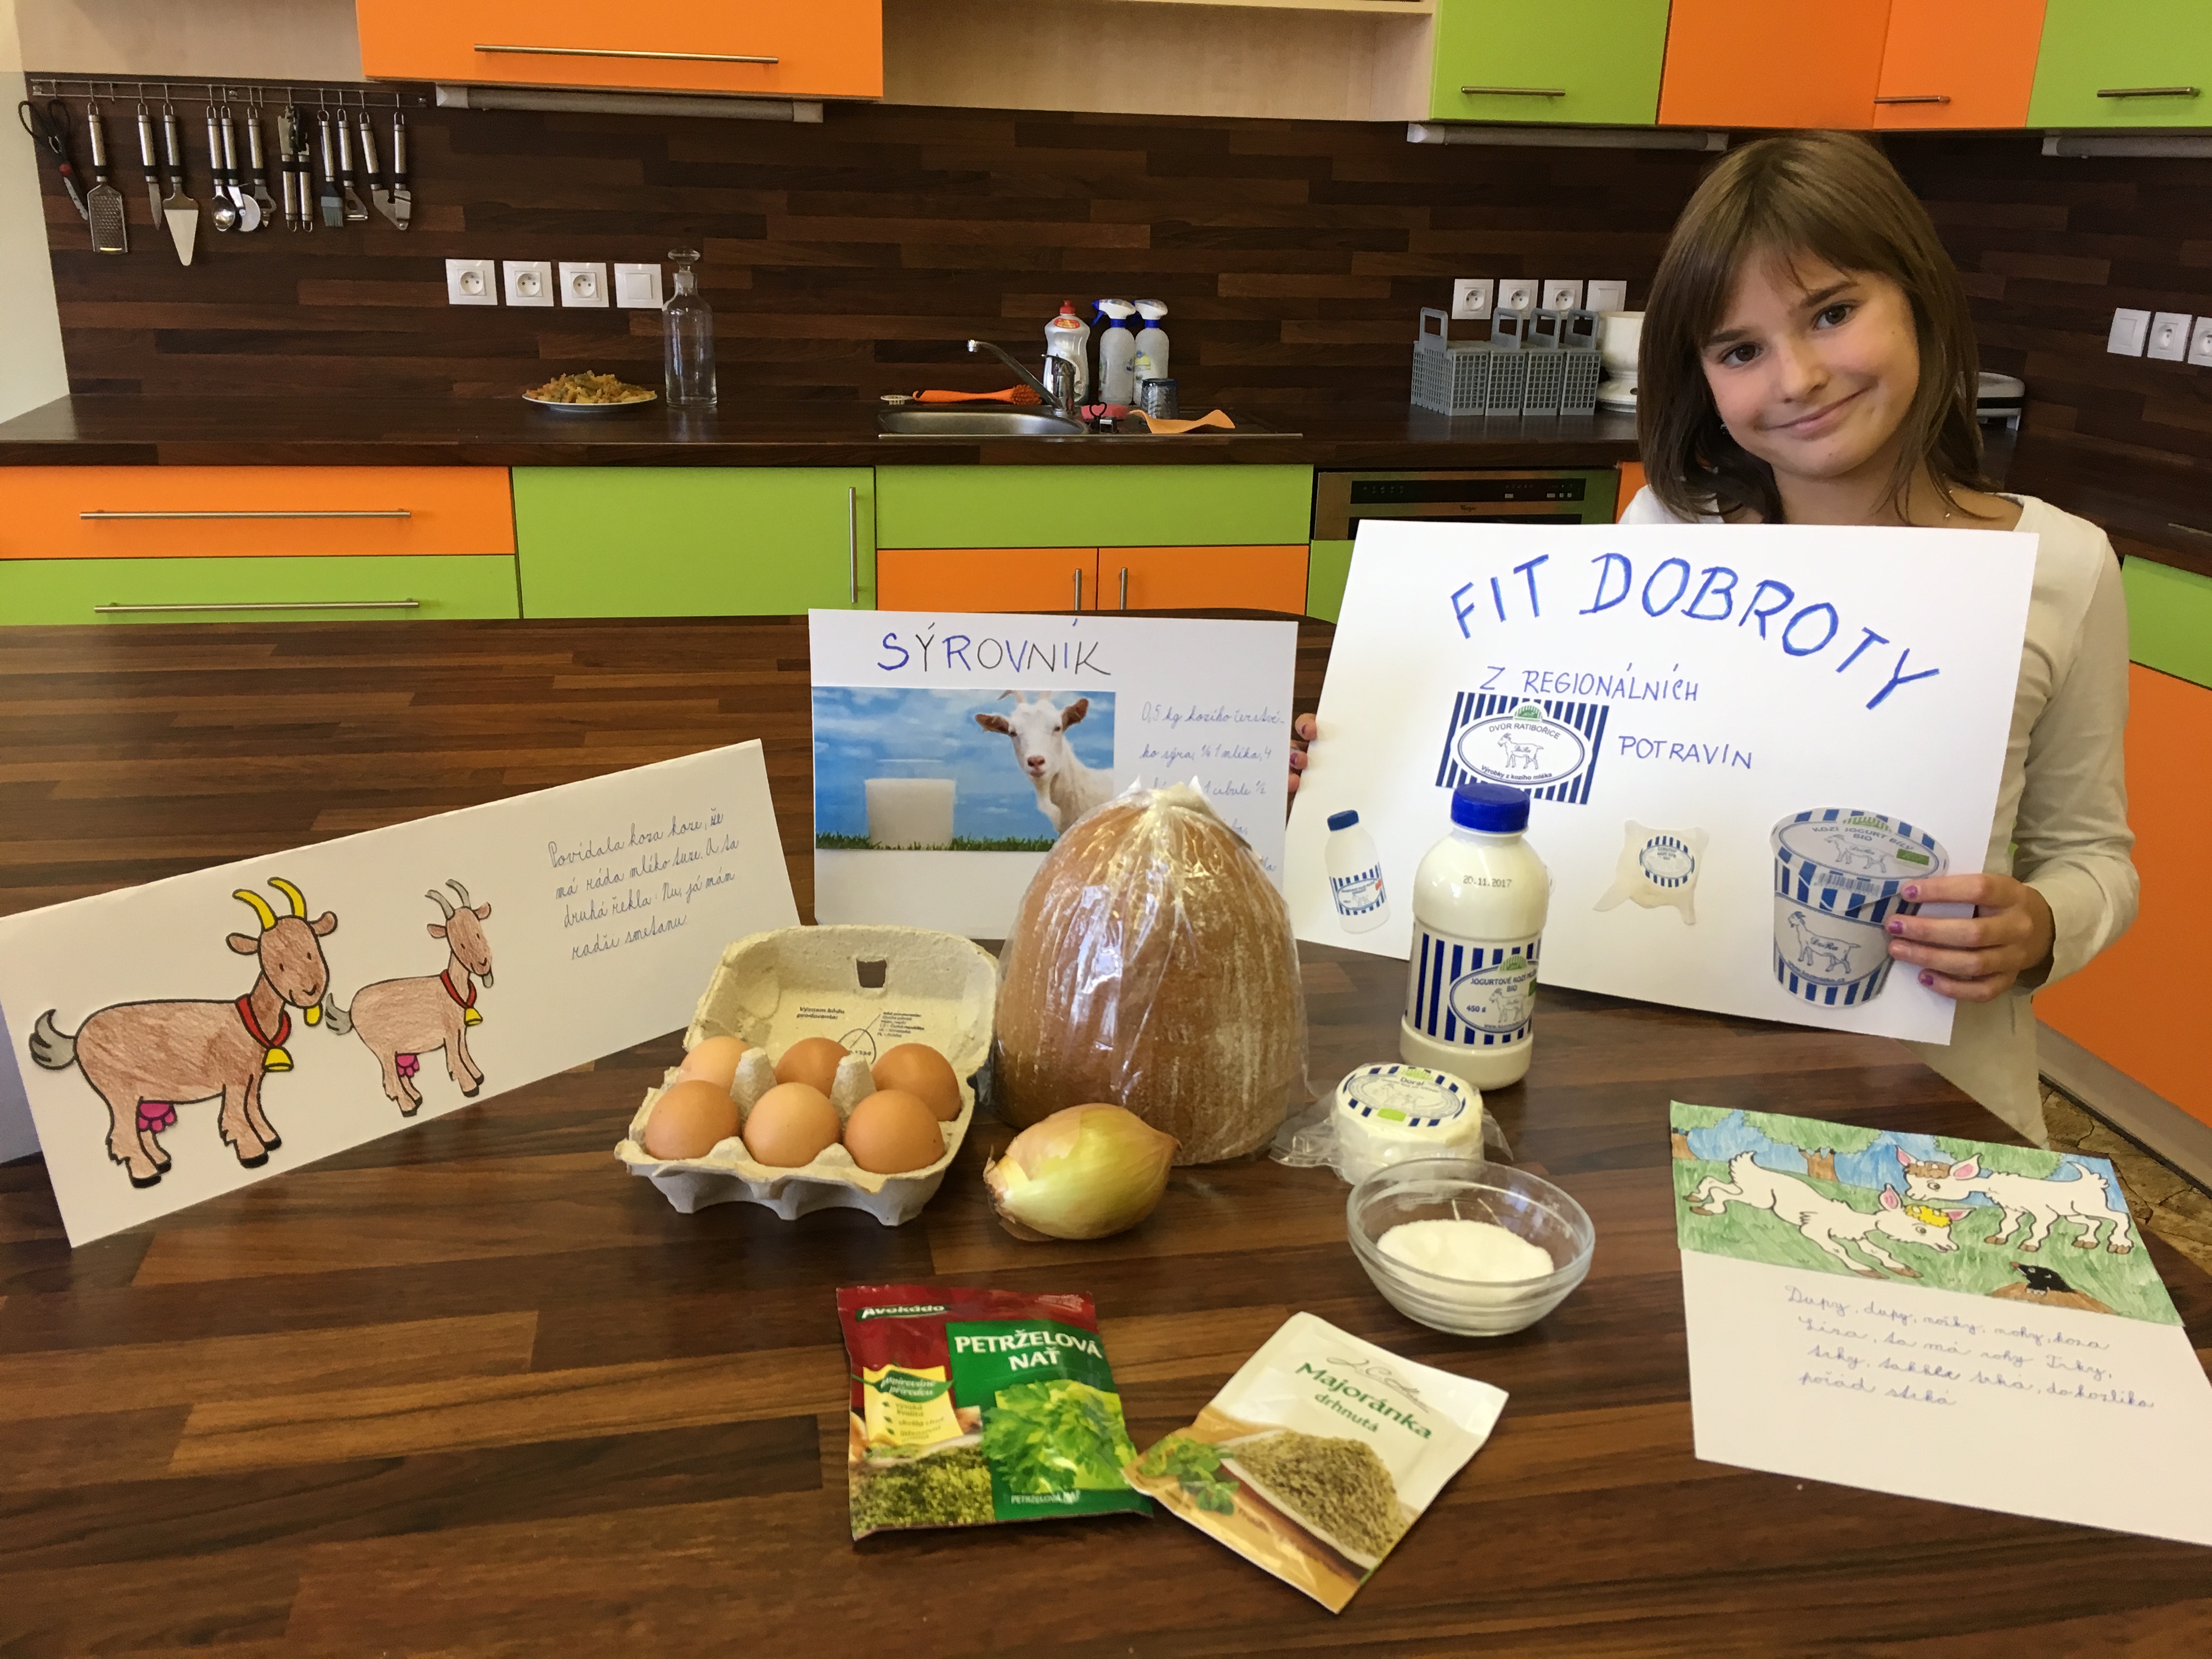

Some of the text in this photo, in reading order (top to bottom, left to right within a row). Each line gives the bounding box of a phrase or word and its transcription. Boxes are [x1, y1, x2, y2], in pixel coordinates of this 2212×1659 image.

[1450, 552, 1940, 710] FIT DOBROTY
[877, 618, 1111, 676] SÝROVNÍK
[1480, 662, 1699, 702] Z REGIONÁLNÍCH
[1142, 701, 1161, 723] 0,5
[1162, 706, 1183, 730] kg
[1184, 704, 1232, 723] kozího
[1488, 722, 1561, 740] DVŮR RATIBOŘICE
[1264, 746, 1272, 759] 4
[1618, 735, 1753, 769] POTRAVIN
[1481, 764, 1504, 778] Výrobky
[1212, 780, 1251, 795] cibule
[548, 836, 624, 868] Povídala
[628, 822, 664, 847] koza
[667, 815, 707, 838] koze,
[1844, 827, 1888, 839] JOGURT
[1853, 833, 1872, 842] BIO
[555, 876, 578, 900] má
[585, 867, 624, 891] ráda
[629, 852, 670, 878] mléko
[1463, 874, 1513, 888] 20.11.2017
[563, 899, 608, 929] druhá
[685, 874, 703, 904] já
[705, 866, 735, 889] mám
[571, 933, 620, 961] radši
[1466, 1005, 1481, 1013] 450
[954, 1329, 1103, 1359] PETRŽELOVÁ
[1883, 1331, 1917, 1347] ta
[1923, 1341, 1973, 1356] má
[2054, 1331, 2110, 1350] koza
[1008, 1346, 1061, 1372] NAŤ
[1295, 1362, 1432, 1439] Majoránka
[1314, 1392, 1380, 1434] drhnutá
